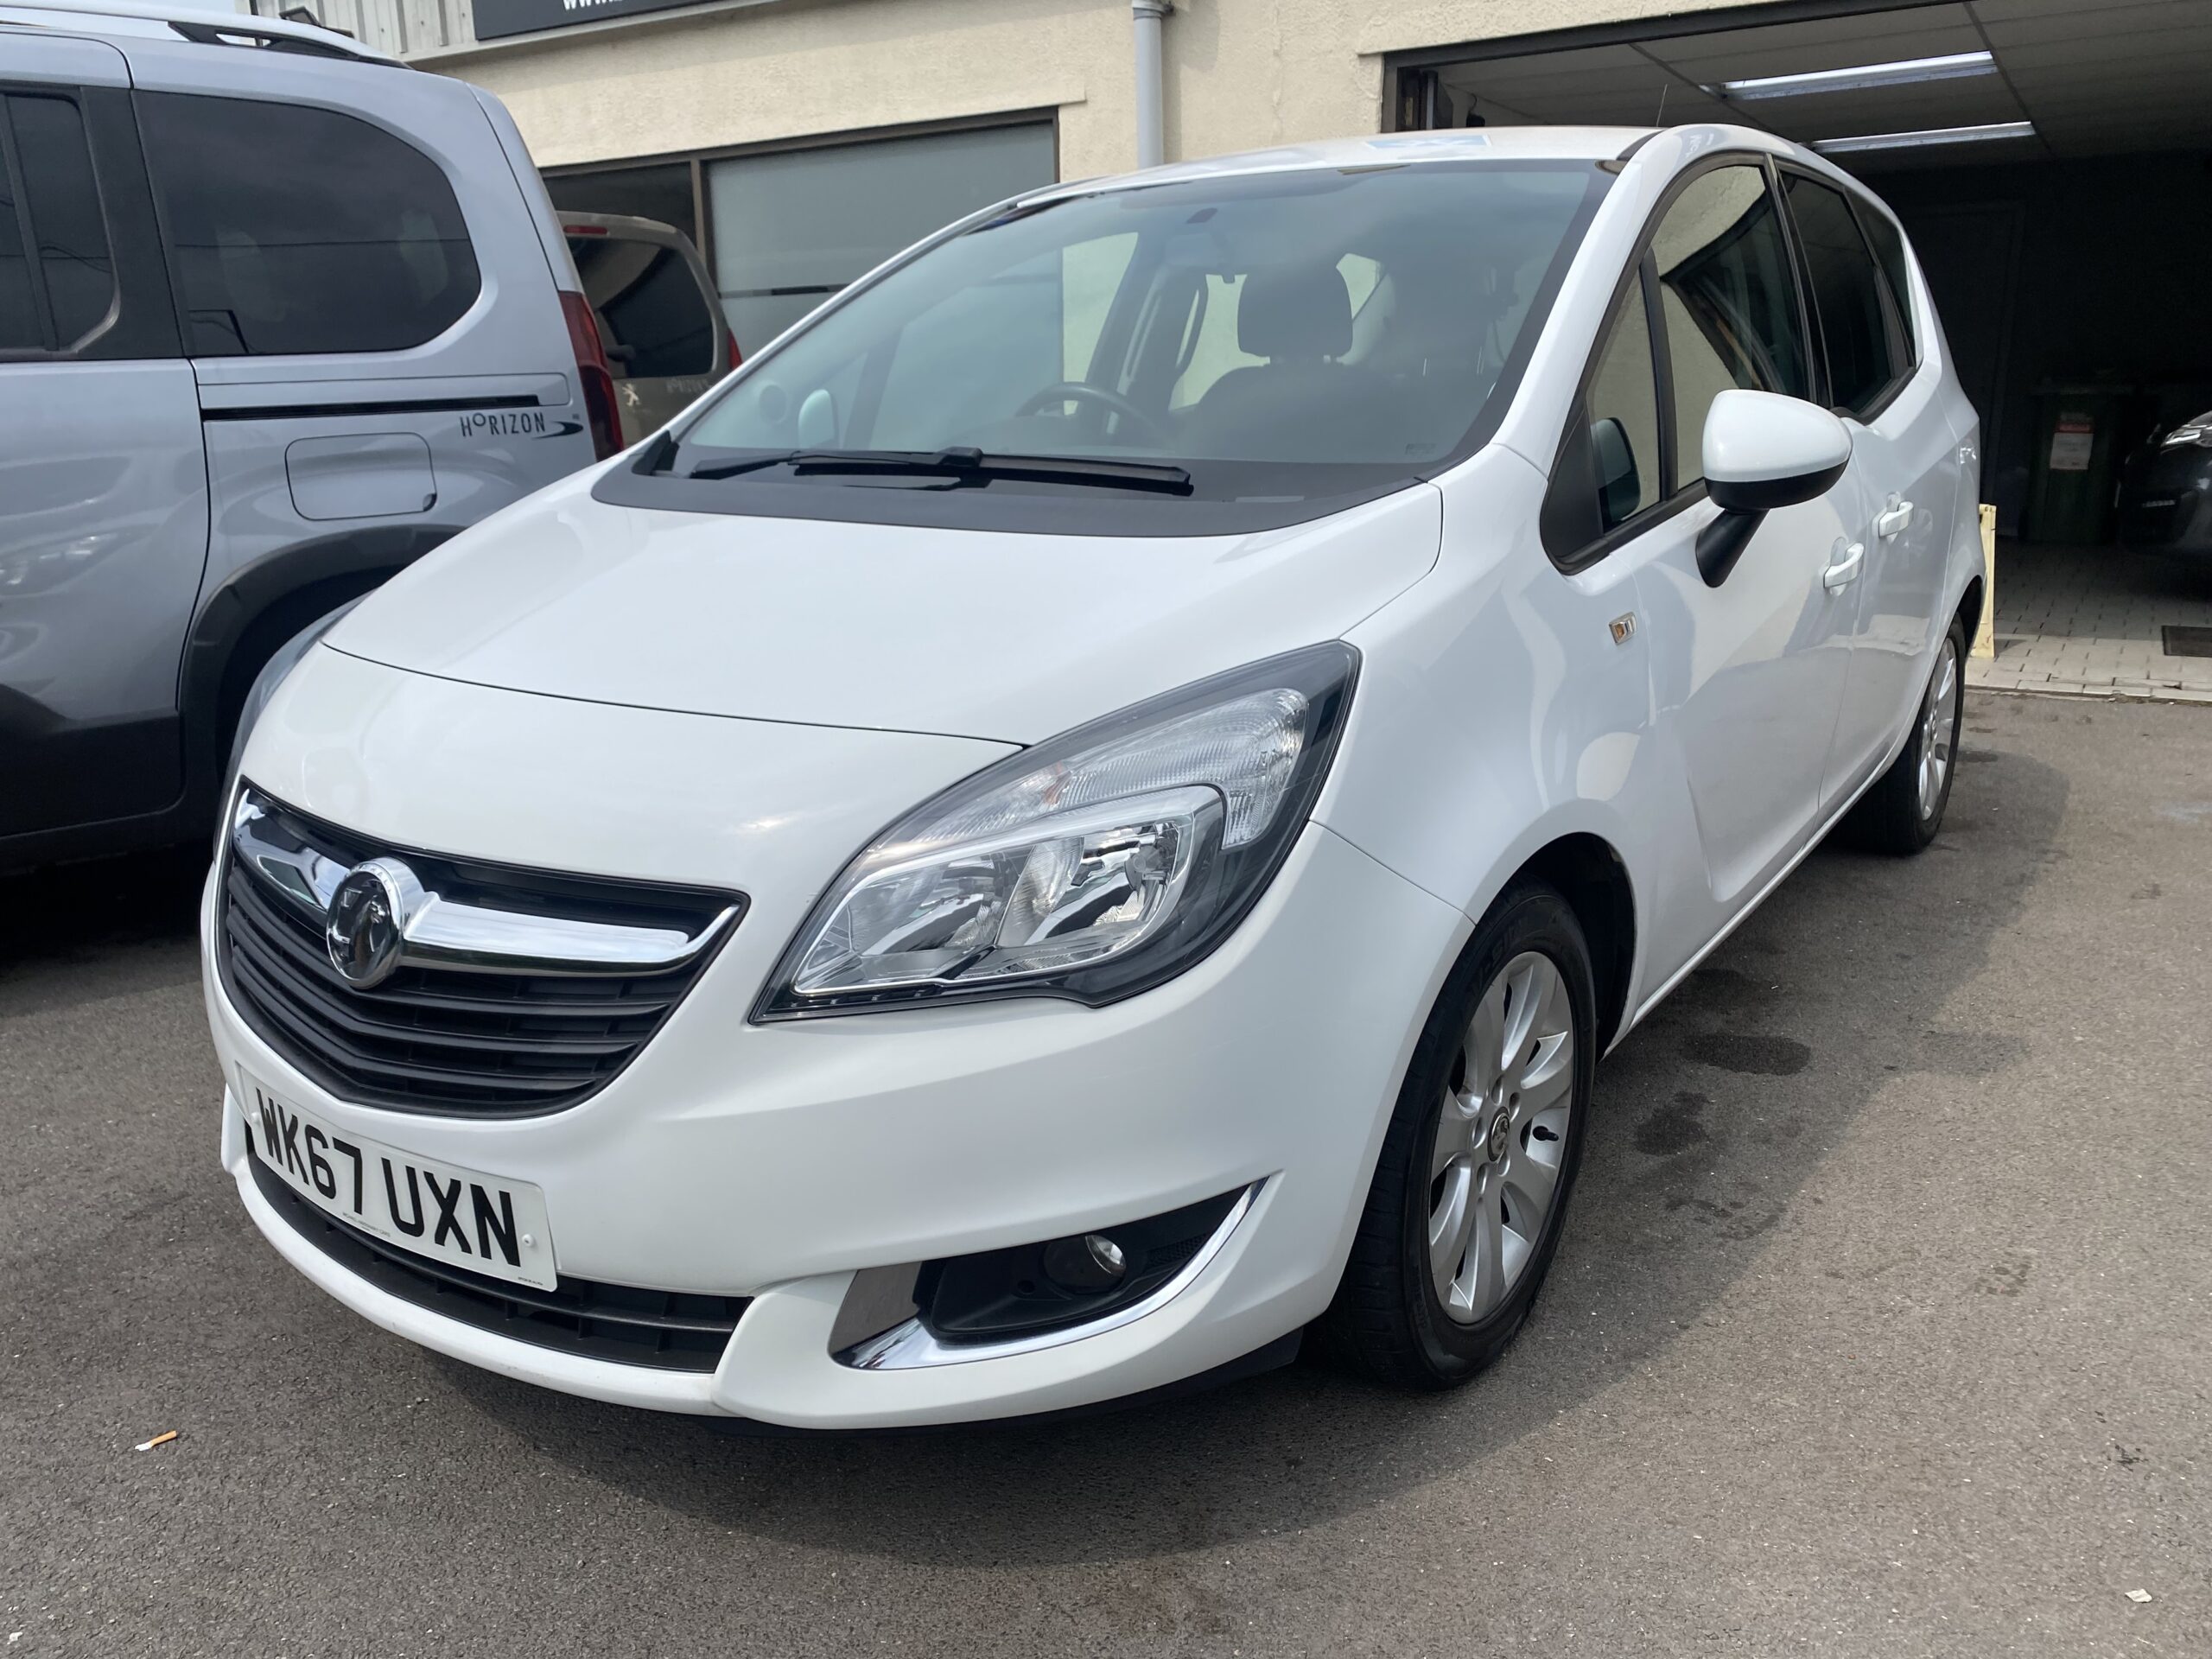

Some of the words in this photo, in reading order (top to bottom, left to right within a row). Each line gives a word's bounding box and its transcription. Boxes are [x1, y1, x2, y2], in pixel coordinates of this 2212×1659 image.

[460, 411, 546, 437] HORIZON
[256, 1087, 363, 1215] WK67
[380, 1157, 521, 1268] UXN
